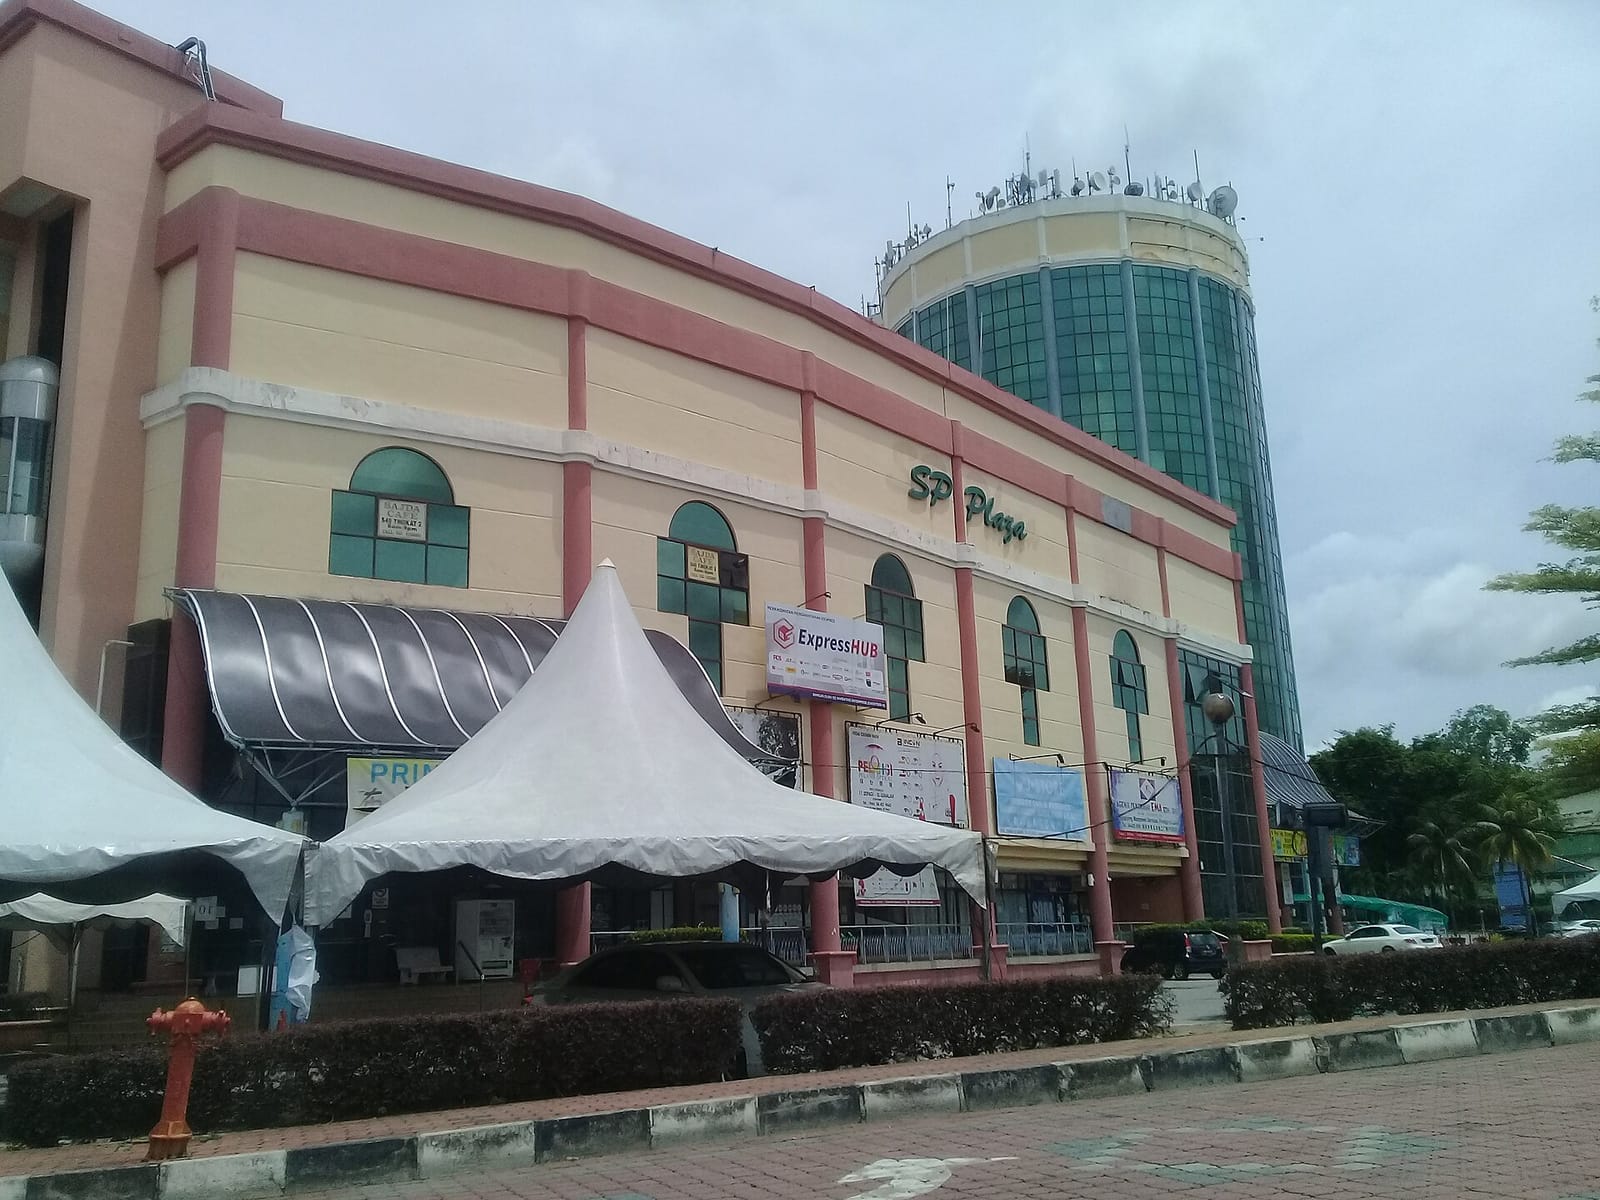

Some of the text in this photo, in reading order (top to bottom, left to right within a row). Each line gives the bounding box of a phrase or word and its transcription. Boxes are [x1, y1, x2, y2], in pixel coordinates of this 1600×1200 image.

[908, 465, 1027, 544] SP Plaza
[798, 628, 878, 658] ExpressHUB
